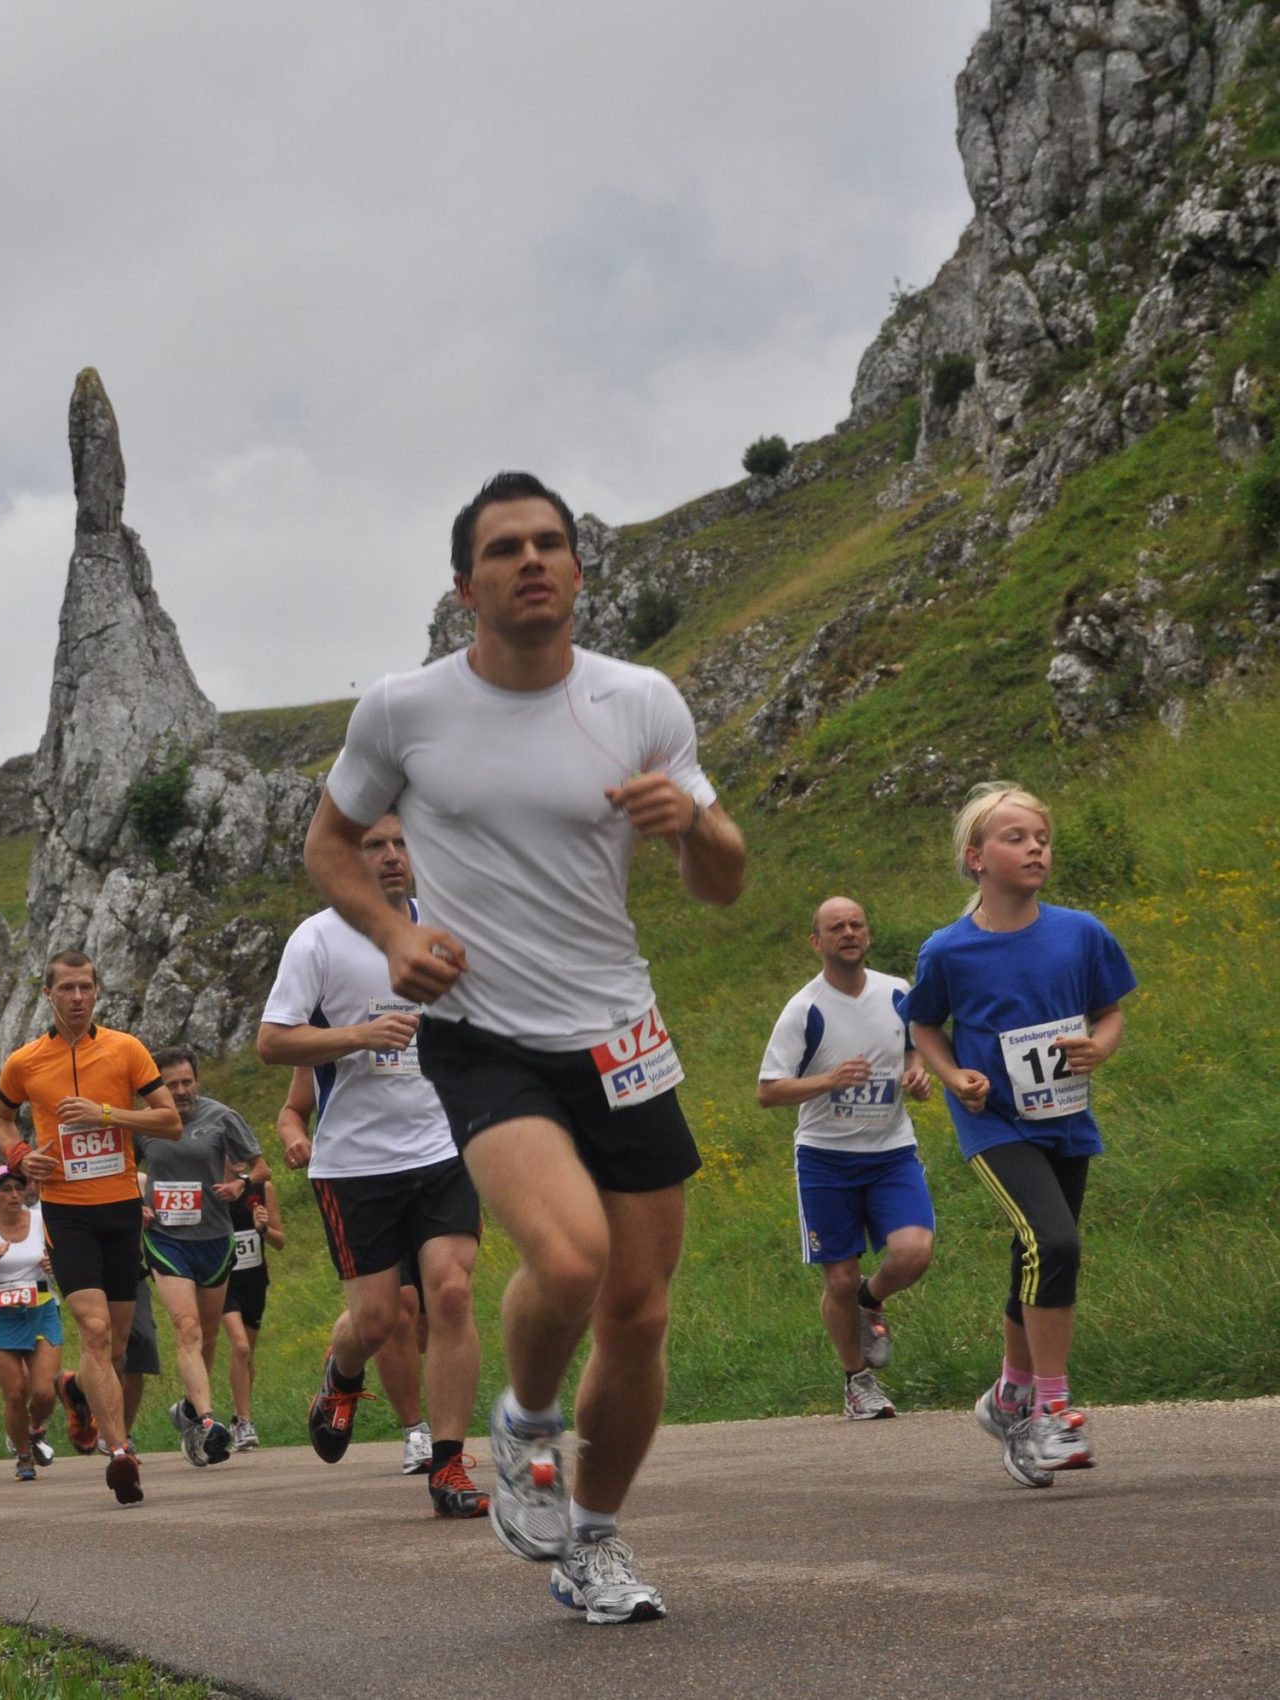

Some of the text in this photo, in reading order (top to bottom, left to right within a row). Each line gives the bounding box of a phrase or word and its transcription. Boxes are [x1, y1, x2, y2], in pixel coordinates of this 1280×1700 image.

[840, 1080, 888, 1104] 337
[71, 1130, 115, 1157] 664
[159, 1192, 195, 1210] 733
[0, 1288, 32, 1305] 679
